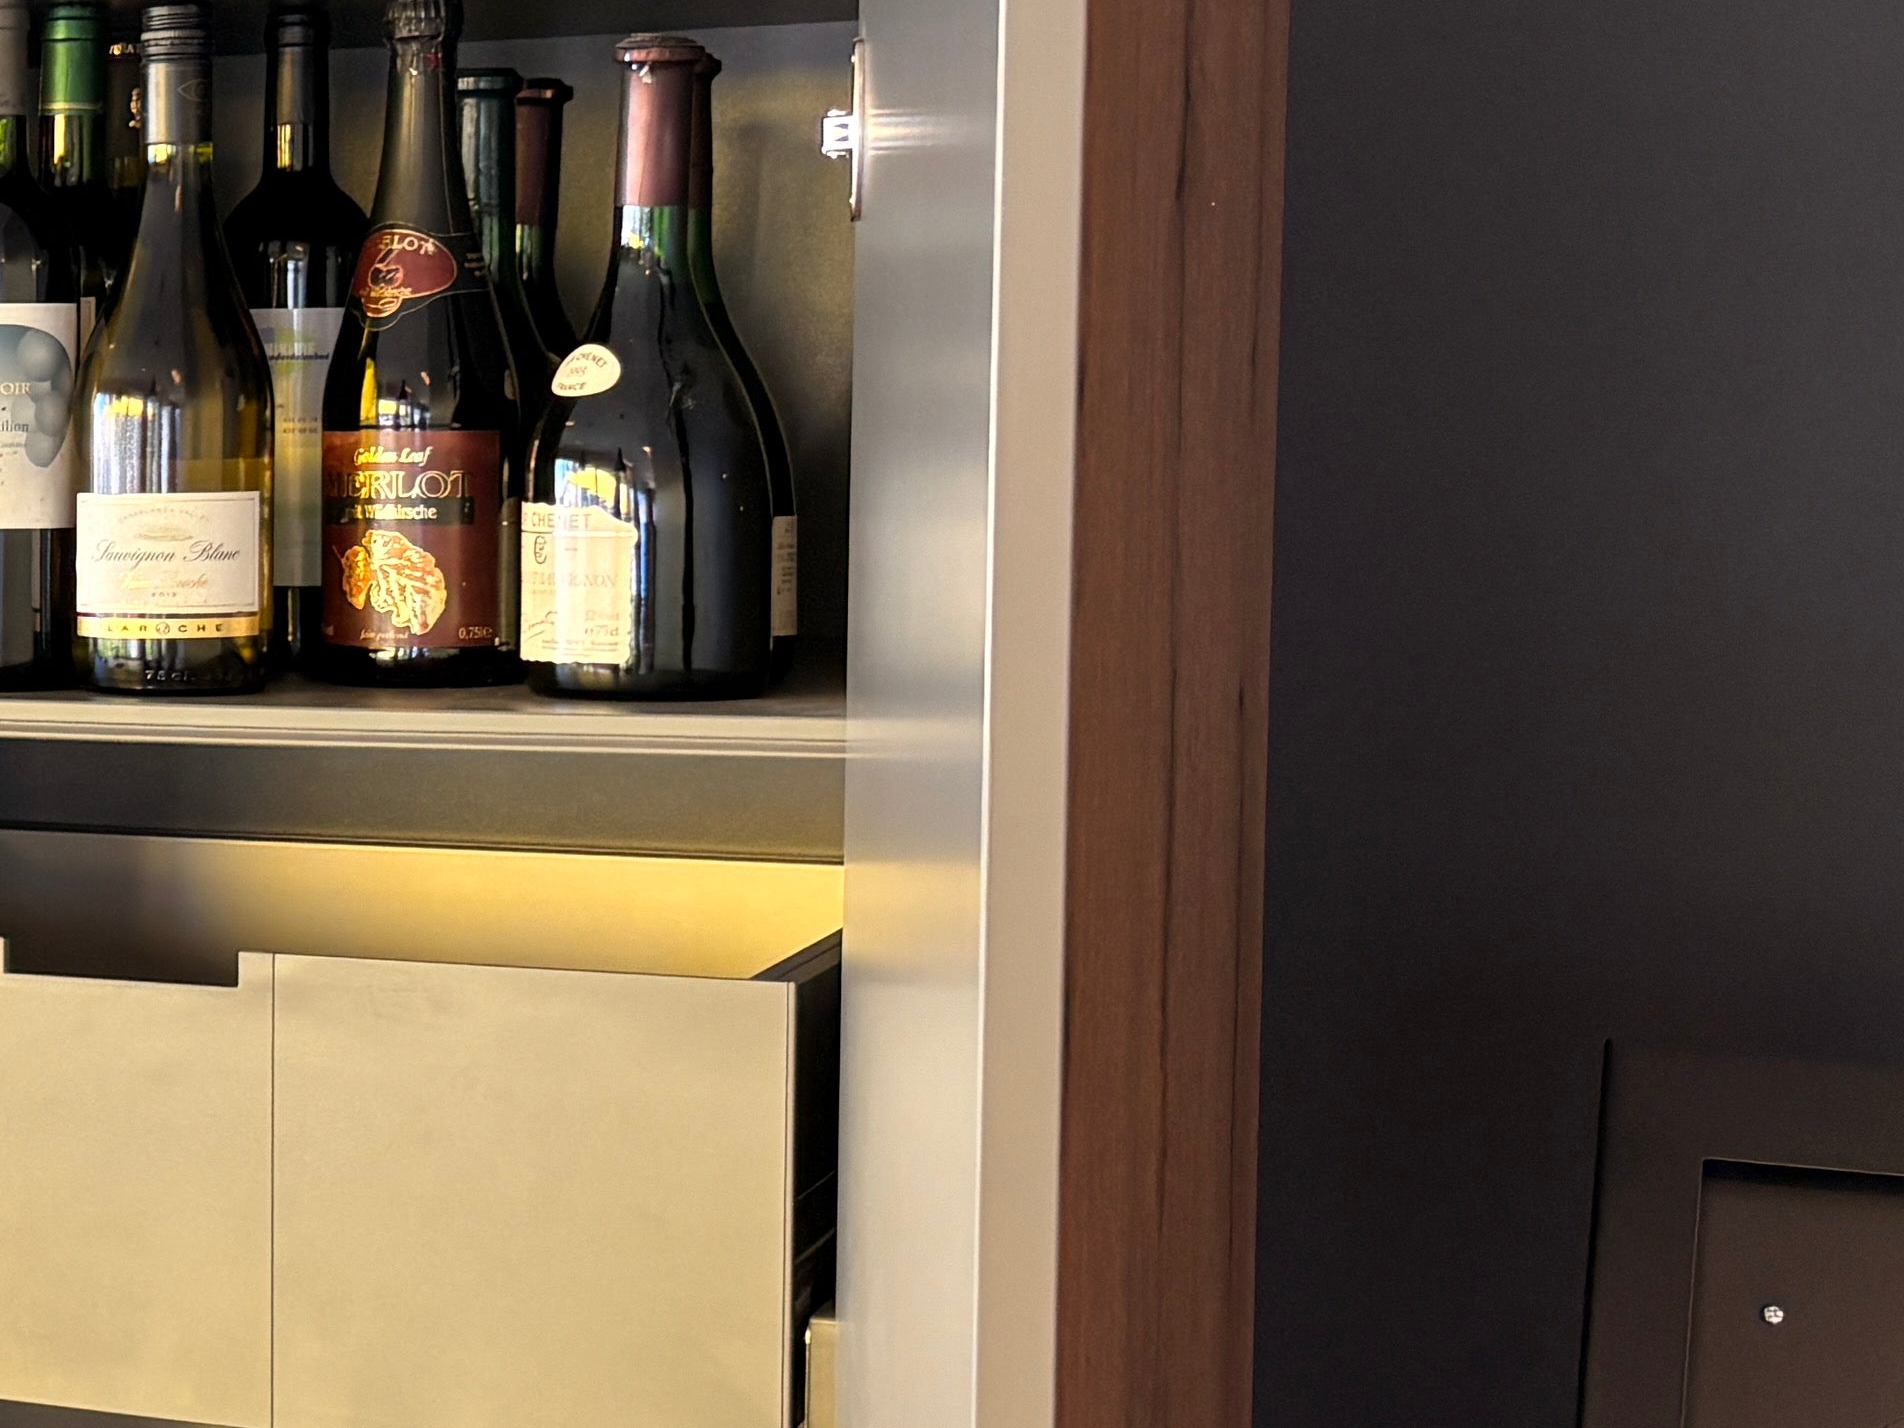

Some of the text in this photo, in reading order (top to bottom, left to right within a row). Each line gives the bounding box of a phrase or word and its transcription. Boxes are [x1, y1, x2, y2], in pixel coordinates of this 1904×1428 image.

[326, 470, 469, 500] MERLOT
[91, 539, 241, 569] Sauvignon Blanc
